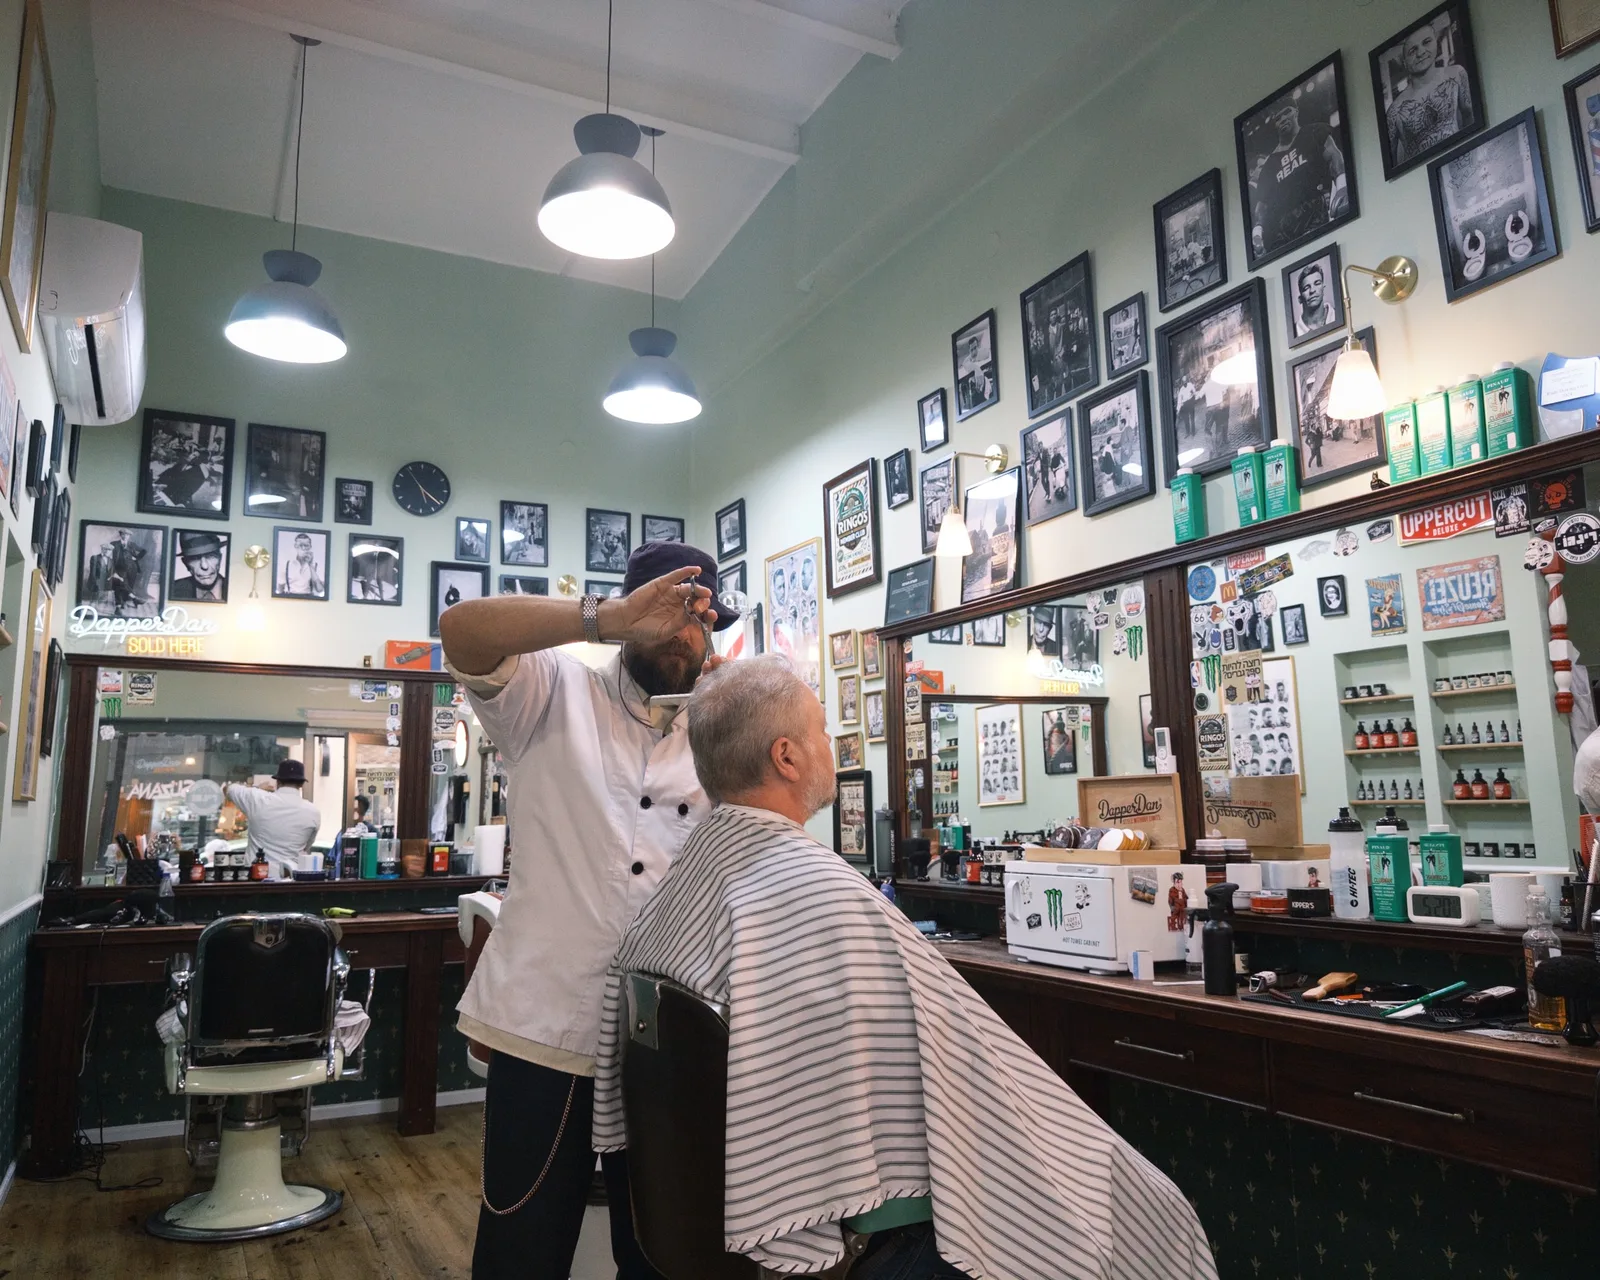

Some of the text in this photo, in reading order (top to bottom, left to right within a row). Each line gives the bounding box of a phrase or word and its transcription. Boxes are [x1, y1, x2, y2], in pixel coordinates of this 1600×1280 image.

[1281, 148, 1298, 167] BE
[1276, 154, 1308, 182] REAL
[1486, 377, 1510, 389] PINAUD
[837, 510, 868, 536] RINGO'S
[1402, 495, 1488, 538] UPPERCUT
[1432, 524, 1459, 537] DELUXE
[1228, 550, 1263, 568] UPPERCUT
[128, 636, 205, 653] SOLD HERE
[1200, 733, 1226, 743] RINGO'S
[1347, 867, 1358, 899] HI-TEC
[1291, 901, 1315, 909] KIPPER'S
